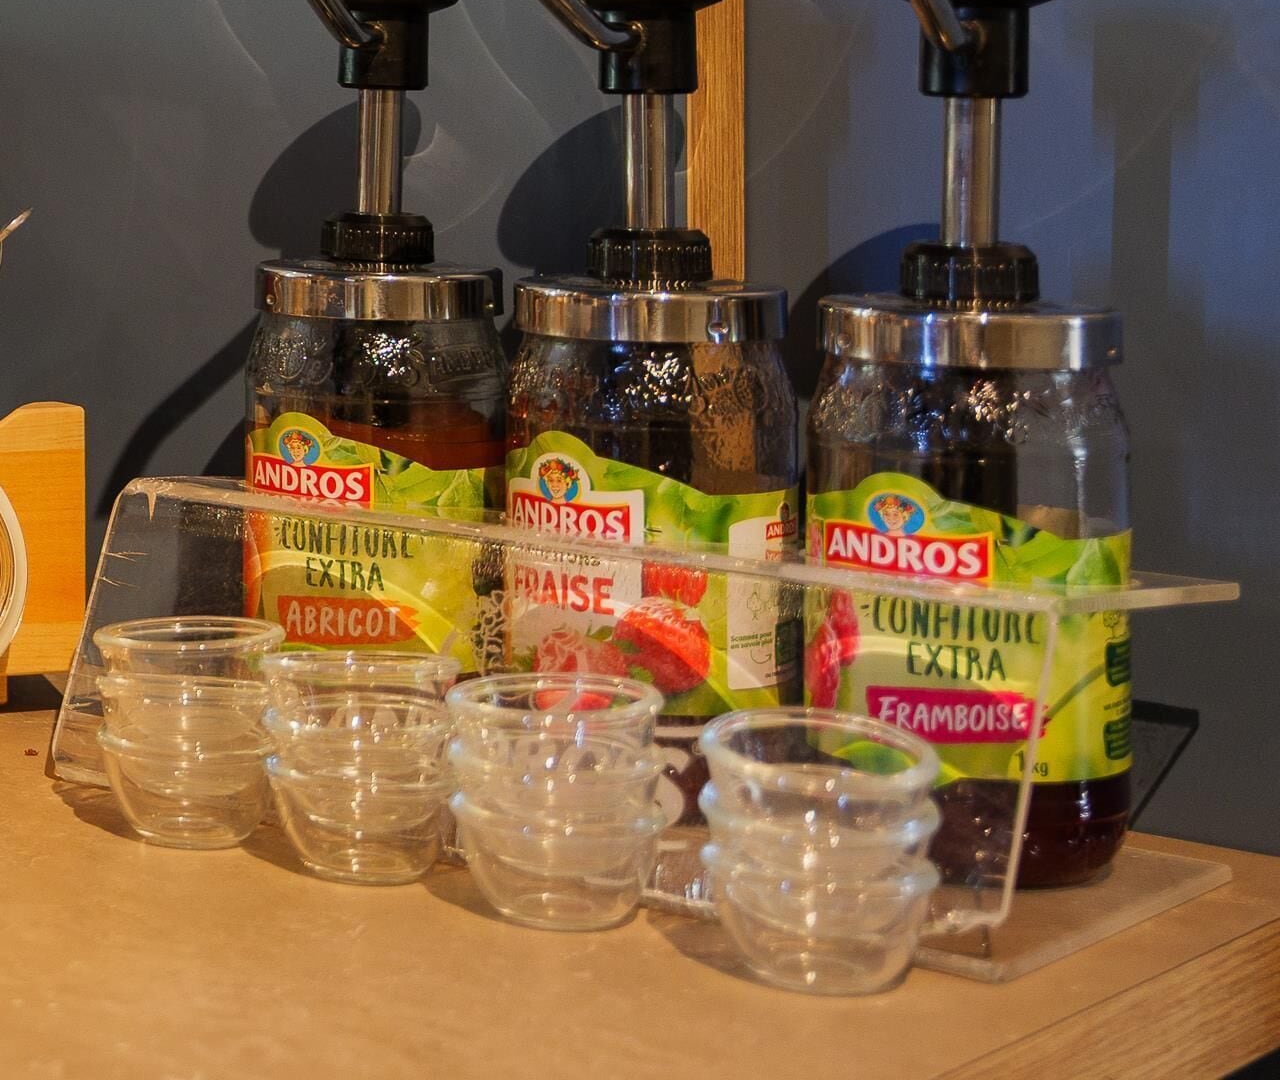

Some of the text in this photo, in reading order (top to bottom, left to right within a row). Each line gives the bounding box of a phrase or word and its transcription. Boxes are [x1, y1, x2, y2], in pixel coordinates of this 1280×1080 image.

[254, 460, 365, 501] ANDROS
[513, 497, 626, 539] ANDROS
[827, 527, 982, 576] ANDROS
[305, 557, 385, 592] EXTRA
[514, 564, 615, 616] FRAISE
[285, 600, 401, 638] ABRICOT
[871, 596, 1042, 645] CONFITURE
[905, 640, 1007, 681] EXTRA
[877, 695, 1029, 733] FRAMBOISE
[1014, 750, 1024, 772] 1
